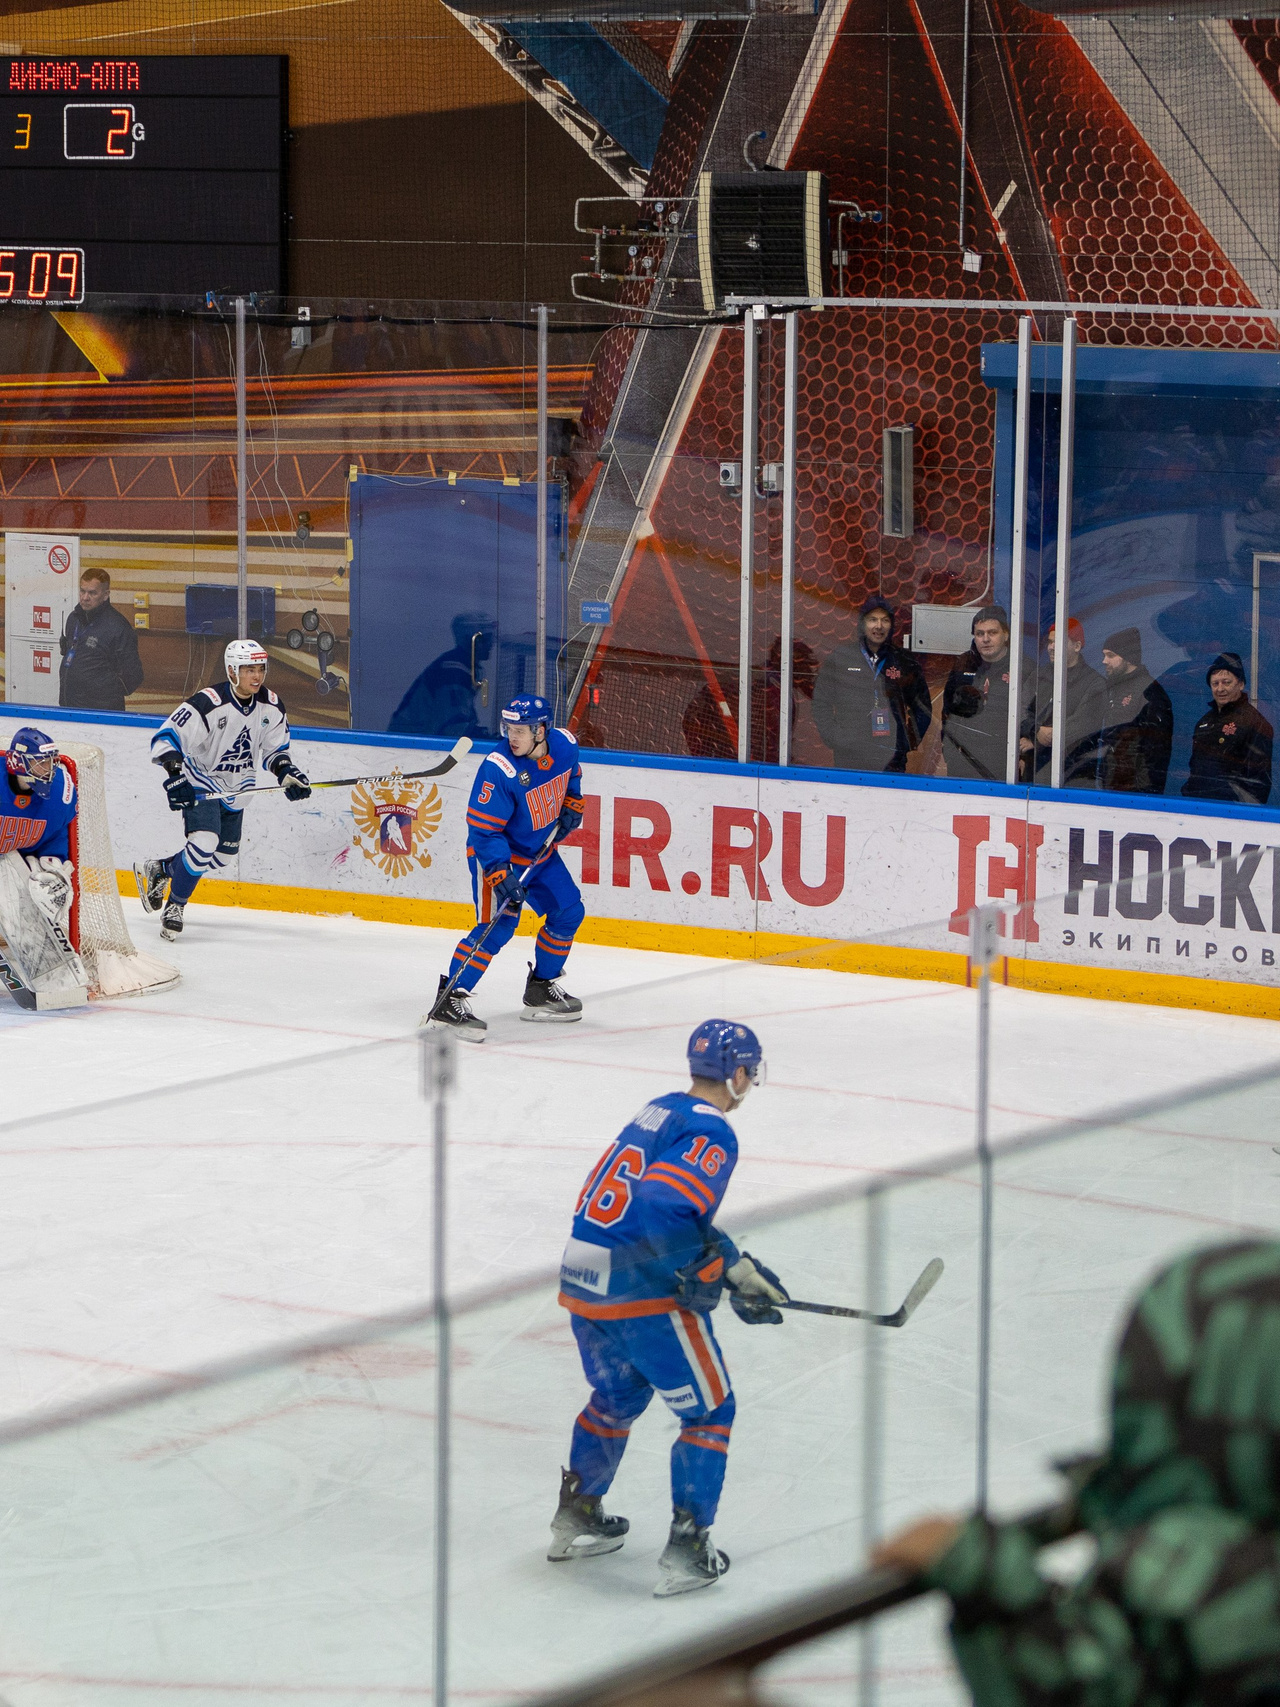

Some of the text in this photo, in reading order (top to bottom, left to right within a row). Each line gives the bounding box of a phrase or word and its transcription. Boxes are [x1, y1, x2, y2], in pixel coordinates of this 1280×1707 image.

[9, 62, 140, 90] ДИНАМО-АЛТА
[14, 113, 32, 149] 3
[106, 109, 130, 154] 2
[131, 122, 145, 141] G
[170, 707, 193, 728] 88
[489, 754, 514, 775] OLIMPBET
[477, 781, 495, 805] 5
[376, 804, 418, 818] ХОККЕЙ РОССИИ
[681, 1135, 728, 1178] 16
[574, 1140, 646, 1229] 16
